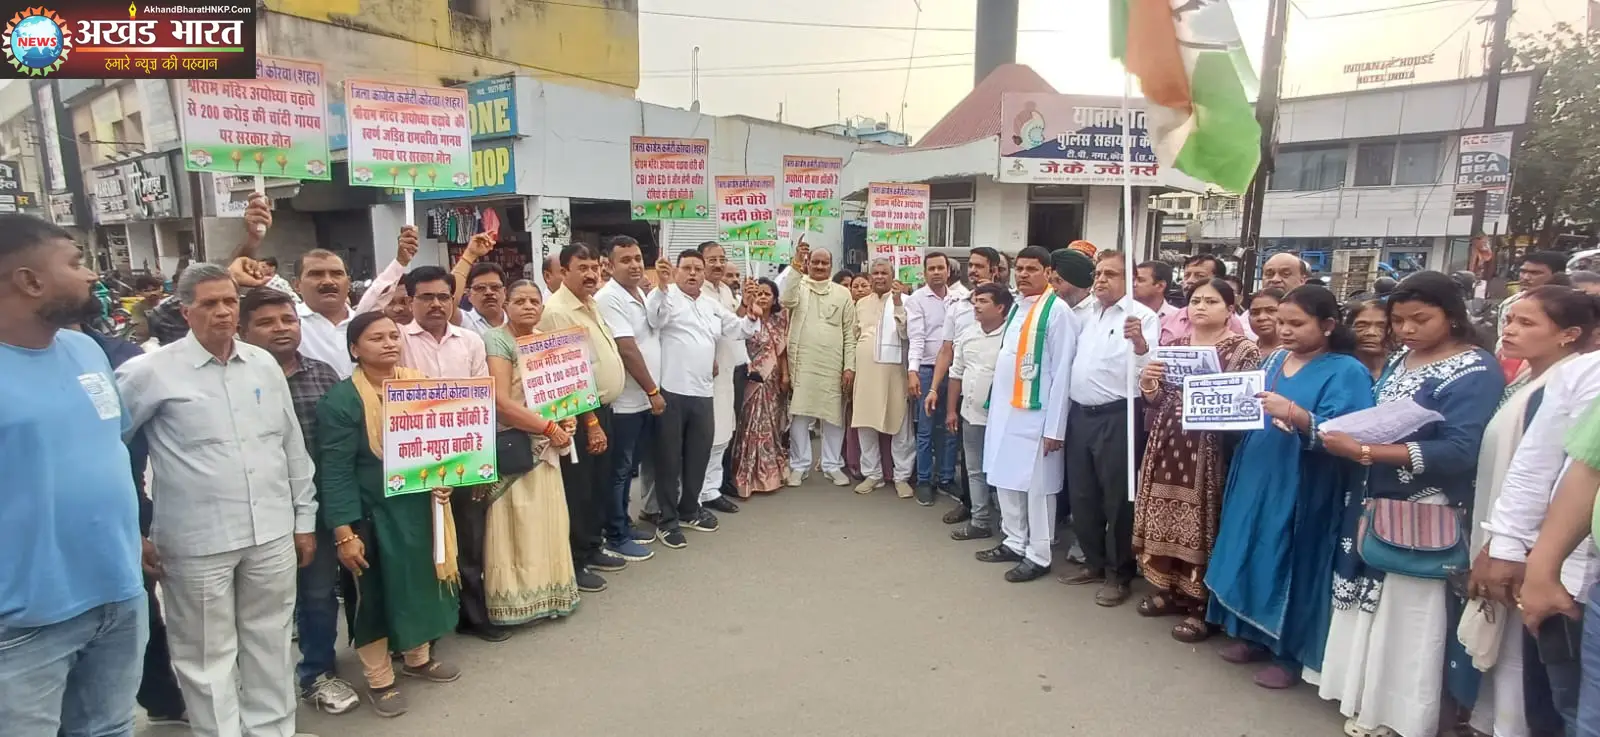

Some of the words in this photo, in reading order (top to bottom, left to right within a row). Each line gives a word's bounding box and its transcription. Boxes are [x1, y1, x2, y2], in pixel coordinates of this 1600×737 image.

[1400, 53, 1436, 67] HOUSE
[1357, 73, 1386, 84] HOTEL
[1388, 71, 1416, 82] INDIA
[222, 81, 248, 100] मंदिर
[250, 84, 288, 105] अयोध्या
[351, 82, 370, 99] जिला
[187, 98, 197, 117] से
[201, 104, 220, 120] 200
[223, 103, 249, 127] करोड़
[252, 106, 266, 124] की
[269, 109, 292, 127] चांदी
[294, 113, 321, 129] गायब
[400, 110, 430, 126] अयोध्या
[219, 128, 233, 143] पर
[236, 130, 269, 146] सरकार
[440, 134, 462, 147] मानस
[1058, 129, 1091, 151] पुलिस
[372, 148, 395, 161] गायब
[396, 150, 407, 162] पर
[409, 151, 435, 163] सरकार
[1461, 153, 1499, 165] BCA
[471, 147, 509, 188] HOP
[1040, 160, 1088, 175] जे.के.
[1460, 163, 1500, 174] BBA
[636, 174, 647, 184] CBI
[657, 174, 666, 184] ED
[1459, 174, 1507, 185] B.Com
[553, 370, 565, 383] 200
[388, 385, 405, 402] जिला
[428, 383, 448, 400] कमेटी
[1191, 391, 1233, 406] विरोध
[1200, 404, 1231, 415] प्रदर्शन
[390, 410, 423, 432] अयोध्या
[426, 409, 437, 429] तो
[439, 411, 454, 428] बस
[481, 404, 489, 425] है
[452, 432, 475, 452] बाकी
[475, 431, 483, 451] है
